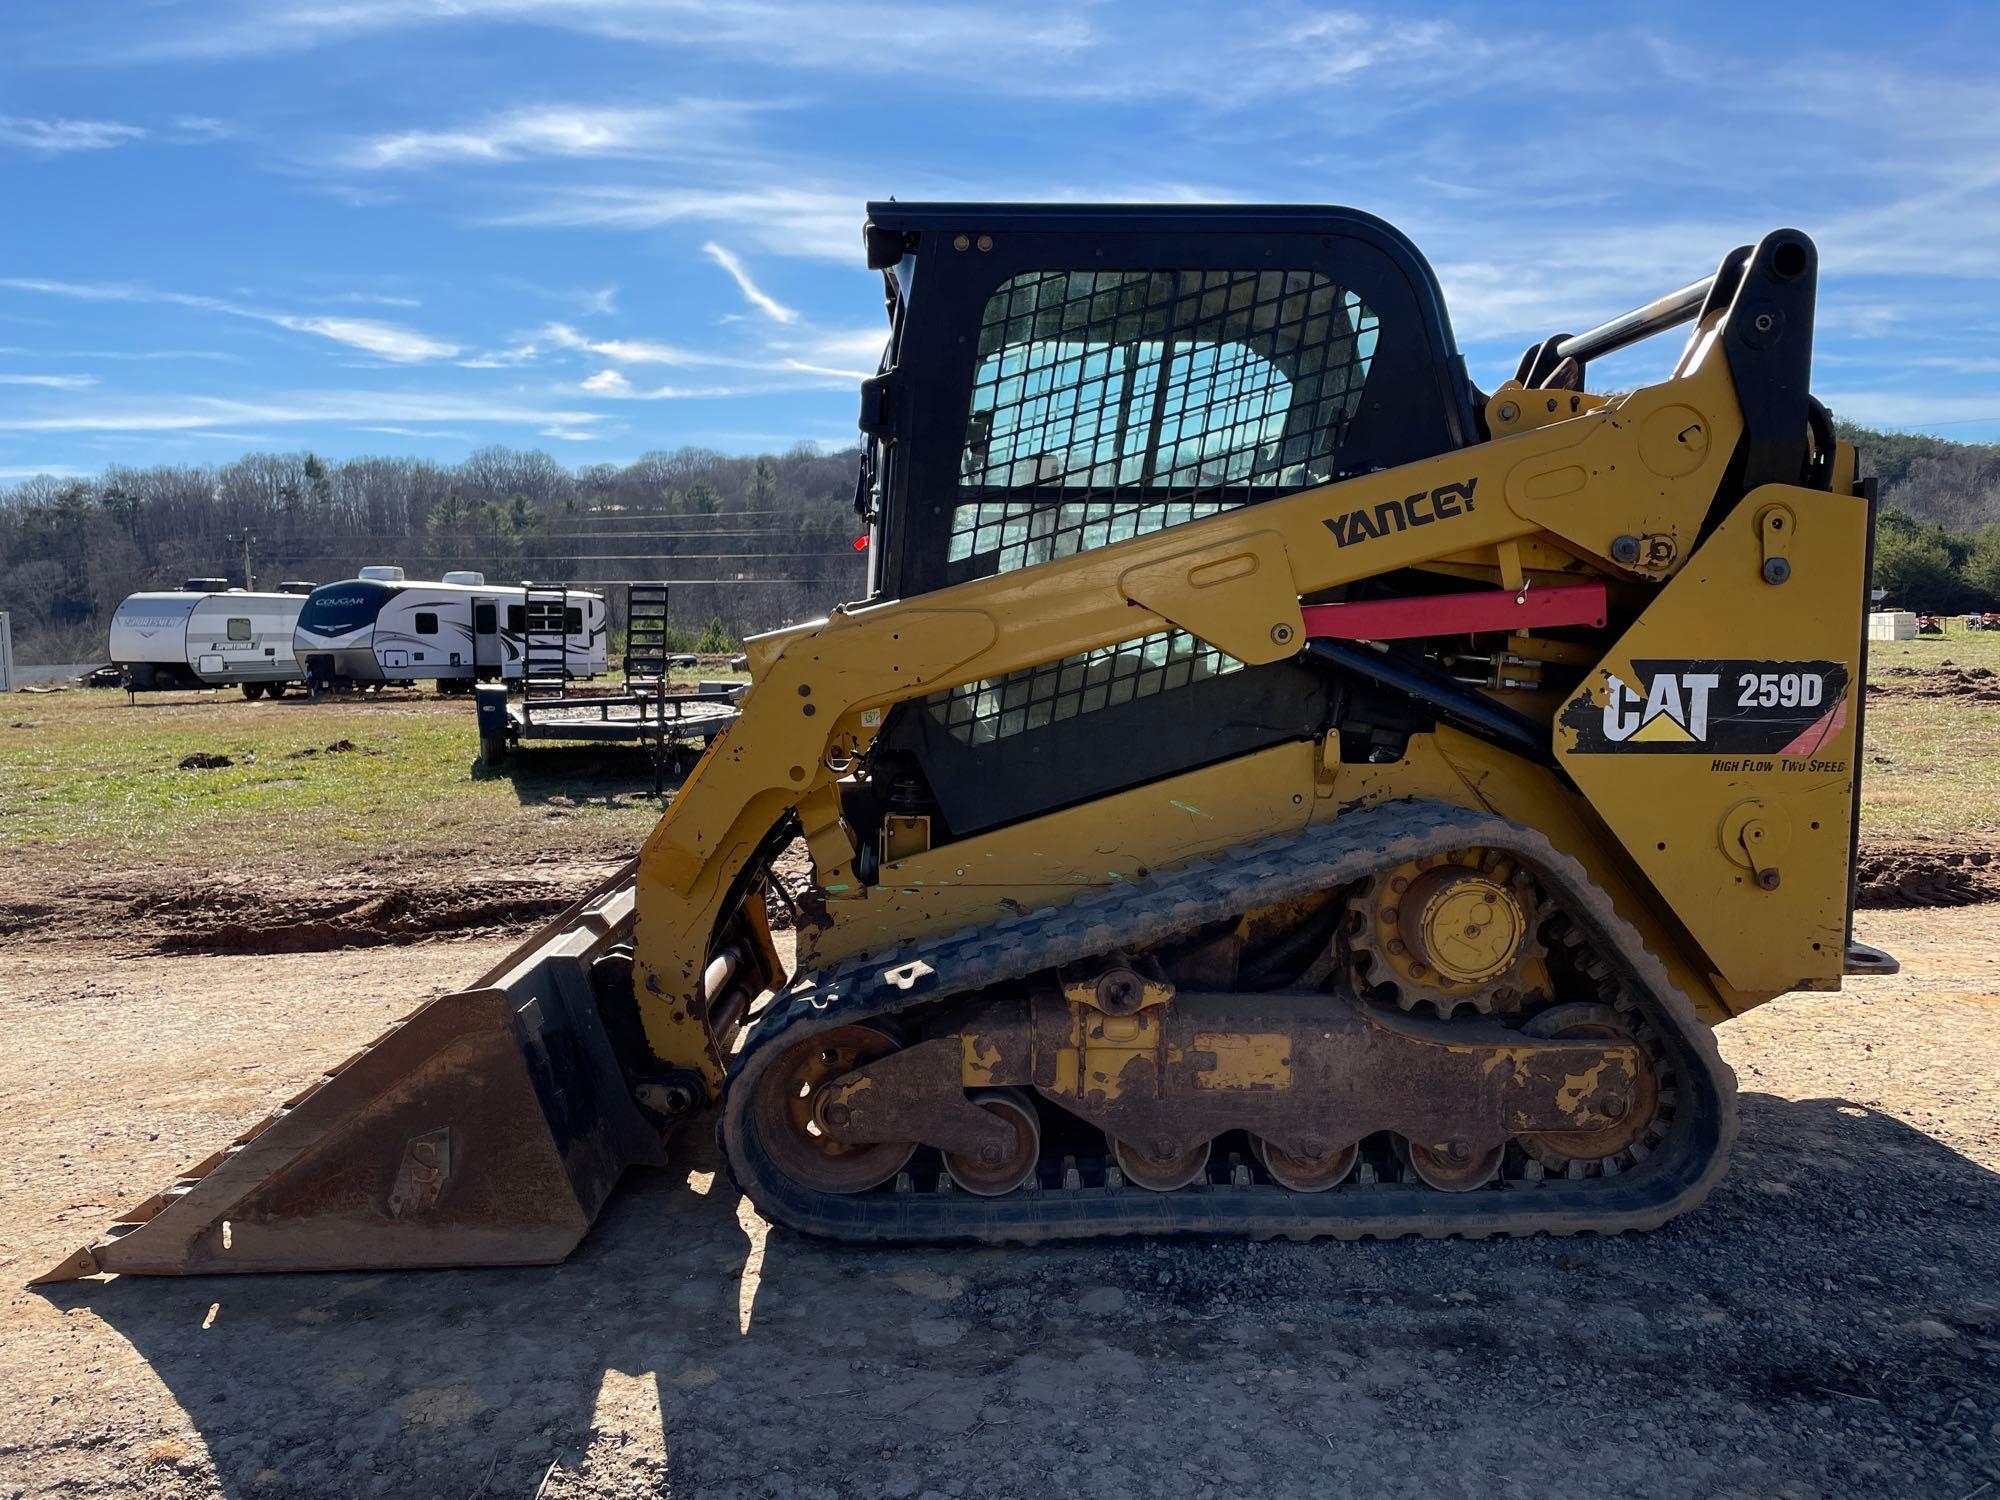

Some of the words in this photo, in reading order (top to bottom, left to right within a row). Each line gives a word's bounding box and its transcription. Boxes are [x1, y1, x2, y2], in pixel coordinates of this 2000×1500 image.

[1321, 477, 1478, 548] YANCEY
[315, 598, 364, 606] COUGAR
[1602, 673, 1719, 742] CAT
[1737, 673, 1823, 708] 259D
[1711, 760, 1739, 772] HIGH
[1742, 760, 1773, 772] FLOW
